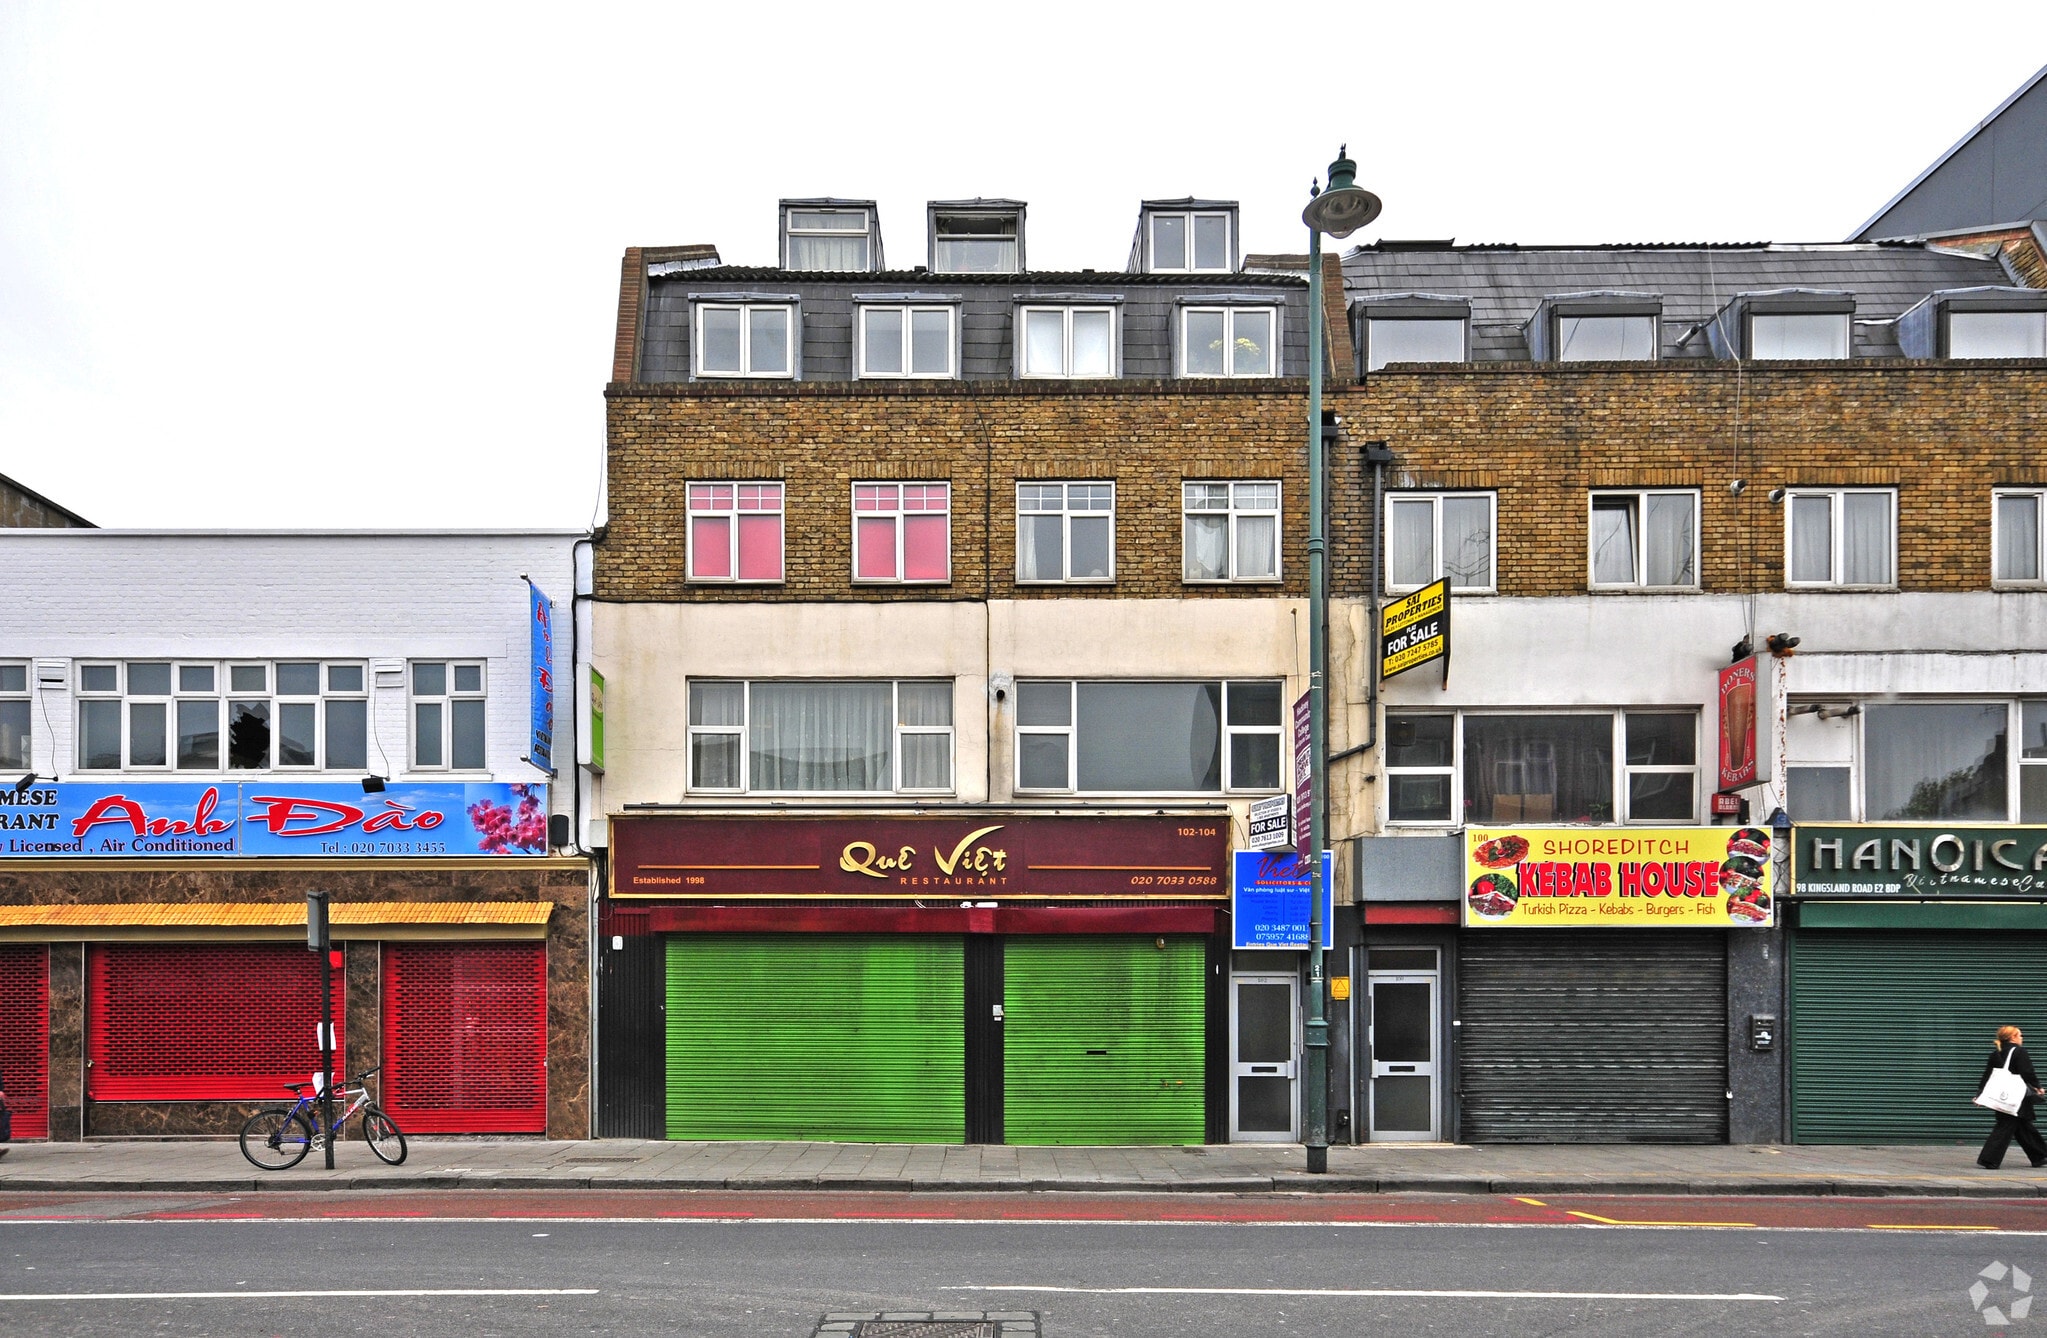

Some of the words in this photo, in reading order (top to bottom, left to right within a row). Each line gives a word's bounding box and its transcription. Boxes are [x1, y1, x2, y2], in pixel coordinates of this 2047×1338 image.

[1406, 594, 1420, 608] SAI
[1385, 594, 1442, 627] PROPERTIES
[1387, 635, 1407, 656] FOR
[1410, 621, 1438, 647] SALE
[1721, 759, 1755, 783] KEBABS
[72, 787, 235, 837] Anh
[1177, 828, 1216, 836] 102-104
[1250, 821, 1266, 834] FOR
[1267, 817, 1286, 830] SALE
[10, 838, 83, 852] Licensed
[101, 838, 126, 852] Air
[132, 837, 235, 852] Conditioned
[1472, 834, 1489, 842] 100
[351, 842, 375, 854] 020
[378, 842, 411, 854] 7033
[414, 842, 446, 854] 3455
[1543, 838, 1689, 855] SHOREDITCH
[633, 876, 681, 885] Established
[685, 877, 705, 885] 1998
[900, 877, 1008, 885] RESTAURANT
[1130, 876, 1153, 885] 020
[1157, 876, 1185, 885] 7033
[1188, 876, 1217, 885] 0588
[1516, 860, 1612, 898] KEBAB
[1619, 860, 1721, 898] HOUSE
[1796, 884, 1807, 893] 98
[1808, 884, 1850, 893] KINGSLAND
[1852, 884, 1873, 893] ROAD
[1875, 884, 1884, 893] E2
[1885, 885, 1902, 893] 8DP
[1522, 902, 1556, 915] Turkish
[1559, 902, 1587, 915] Pizza
[1599, 902, 1634, 915] Kebabs
[1646, 902, 1684, 917] Burgers
[1697, 902, 1716, 915] Fish
[1254, 924, 1270, 932] 020
[1271, 924, 1290, 932] 3487
[1255, 933, 1284, 941] 075957
